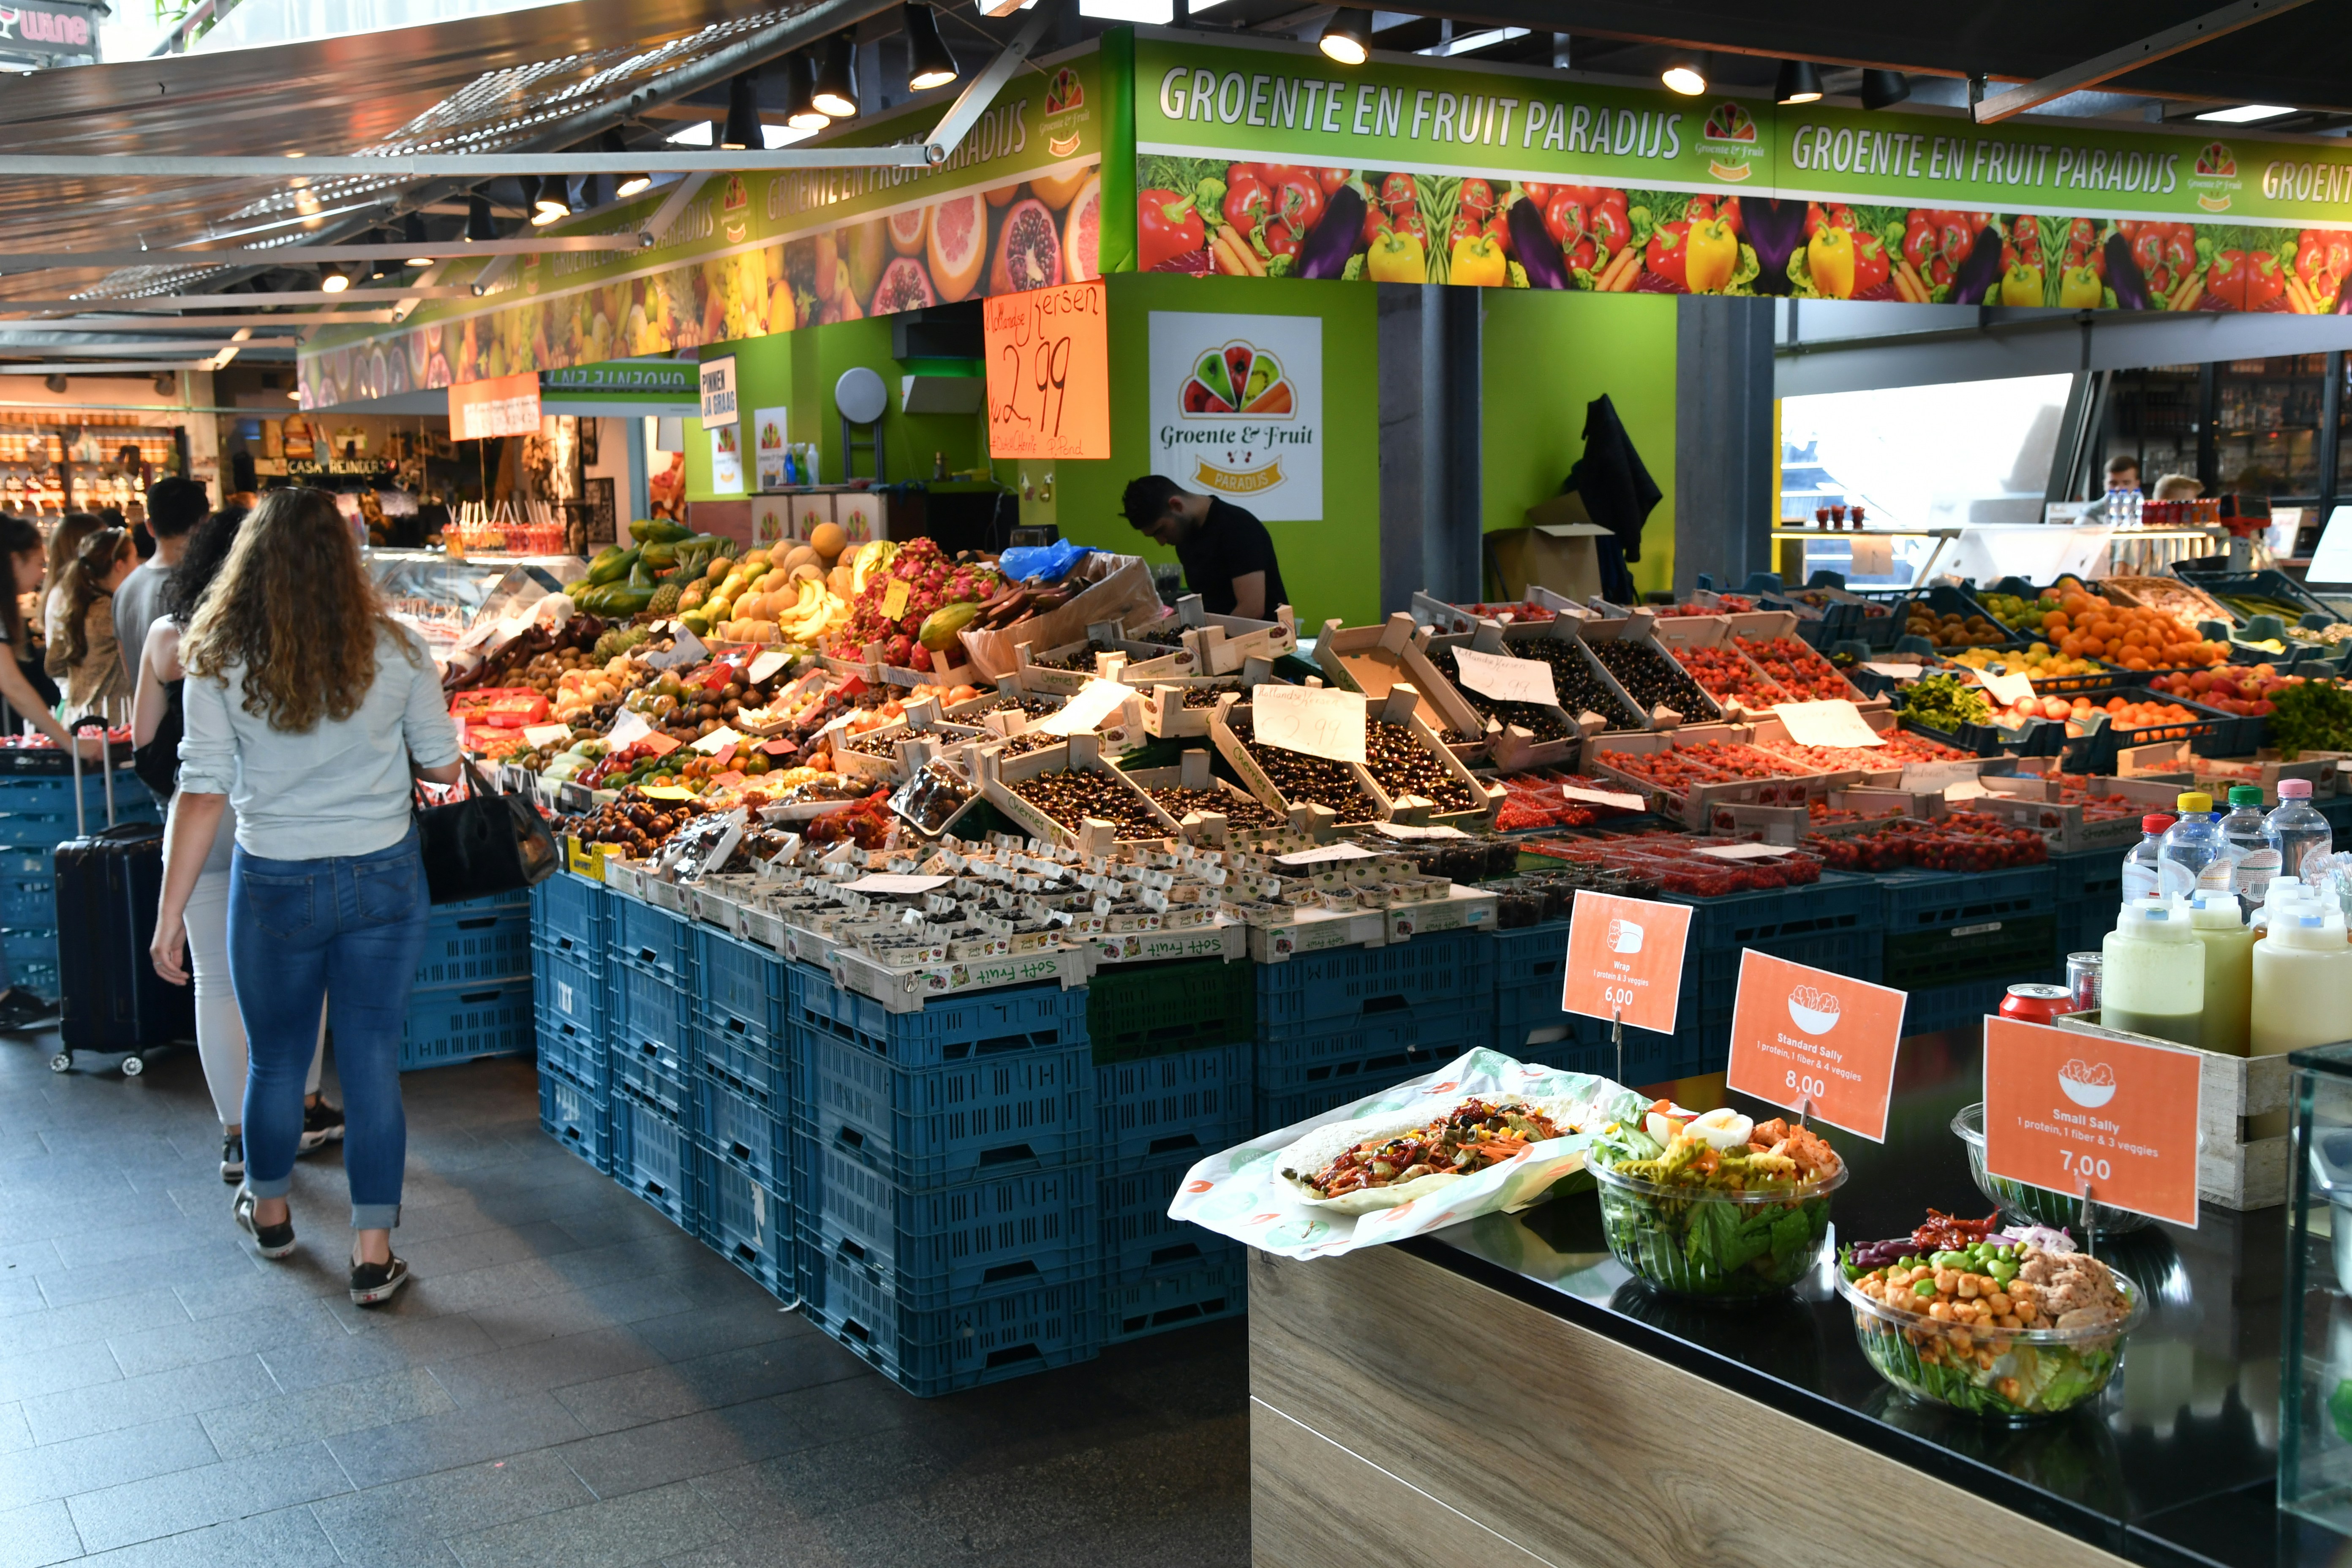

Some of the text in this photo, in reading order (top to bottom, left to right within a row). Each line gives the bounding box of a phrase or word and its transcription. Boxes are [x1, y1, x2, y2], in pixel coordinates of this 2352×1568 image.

[20, 10, 87, 45] wine
[1039, 109, 1090, 136] Groente & Fruit
[1159, 66, 1683, 160] GROENTE EN FRUIT PARADIJS
[1695, 142, 1764, 158] Groente & Fruit
[1791, 124, 2179, 194] GROENTE EN FRUIT PARADIJS
[986, 286, 1099, 347] Hollandse Kersen
[1003, 336, 1071, 437] 2,99
[704, 391, 735, 417] JA GRAAG
[1161, 425, 1313, 449] Groente & Fruit
[287, 460, 323, 474] CASA
[1214, 471, 1269, 490] PARADIJS
[1040, 670, 1073, 686] Cherries
[1258, 685, 1339, 707] Hollandse Kersen
[1233, 746, 1267, 794] Cherries
[1008, 796, 1044, 831] Cherries
[1147, 939, 1221, 957] Soft Fruit
[976, 966, 1015, 984] Fruit
[1020, 961, 1056, 978] Soft
[1597, 971, 1616, 980] protein
[1628, 977, 1649, 986] veggies
[1614, 961, 1630, 972] Wrap
[1605, 986, 1633, 1005] 6,00
[1778, 1033, 1843, 1063] Standard Sally
[1761, 1043, 1790, 1059] protein,
[1797, 1054, 1815, 1066] fiber
[1816, 1060, 1821, 1069] &
[1832, 1066, 1861, 1082] veggies
[1785, 1070, 1824, 1097] 8,00
[2053, 1108, 2120, 1135] Small Sally
[2017, 1117, 2159, 1157] 1 protein, 1 fiber & 3 veggies
[2060, 1149, 2111, 1180] 7,00
